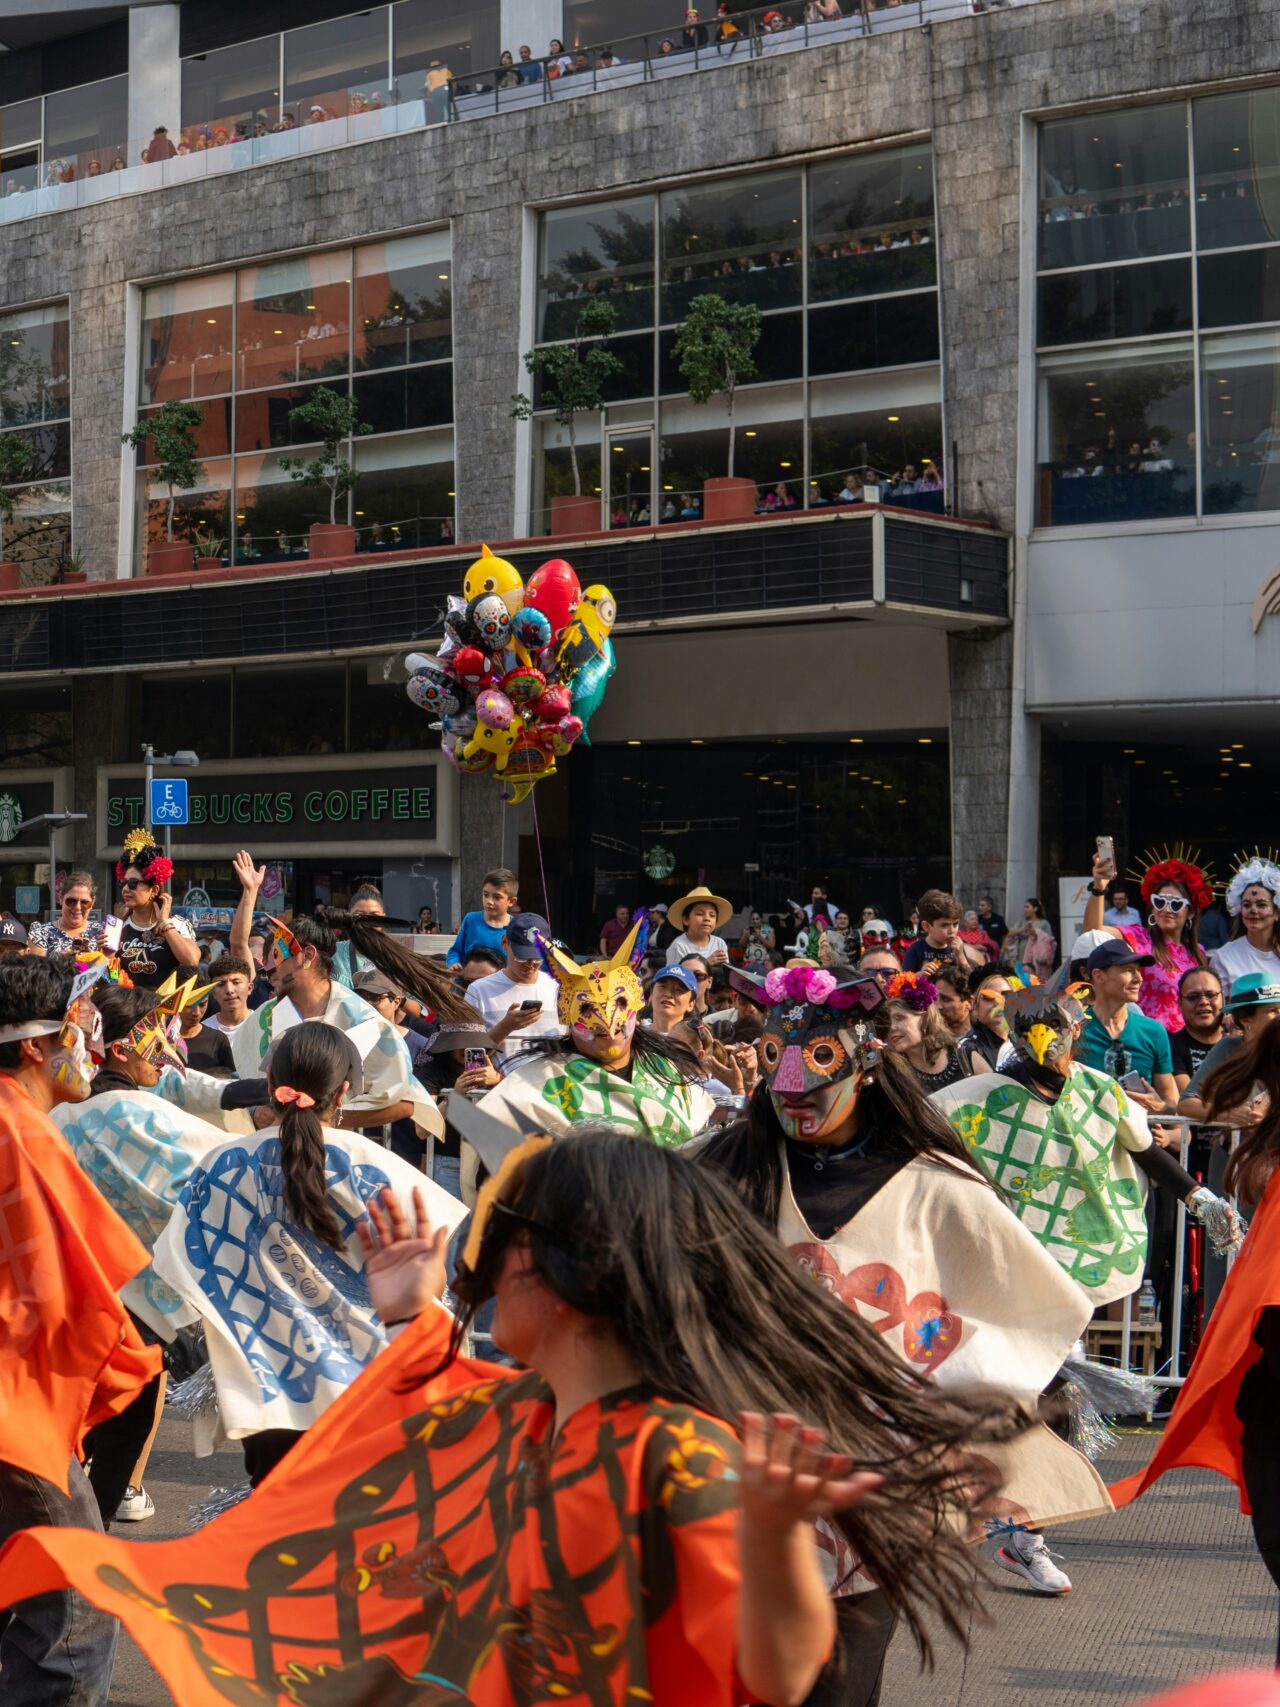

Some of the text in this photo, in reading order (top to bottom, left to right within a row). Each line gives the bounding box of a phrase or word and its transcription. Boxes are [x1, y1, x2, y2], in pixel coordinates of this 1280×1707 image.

[165, 784, 174, 800] E
[107, 788, 431, 827] STBUCKS COFFEE
[122, 937, 165, 952] Cherry
